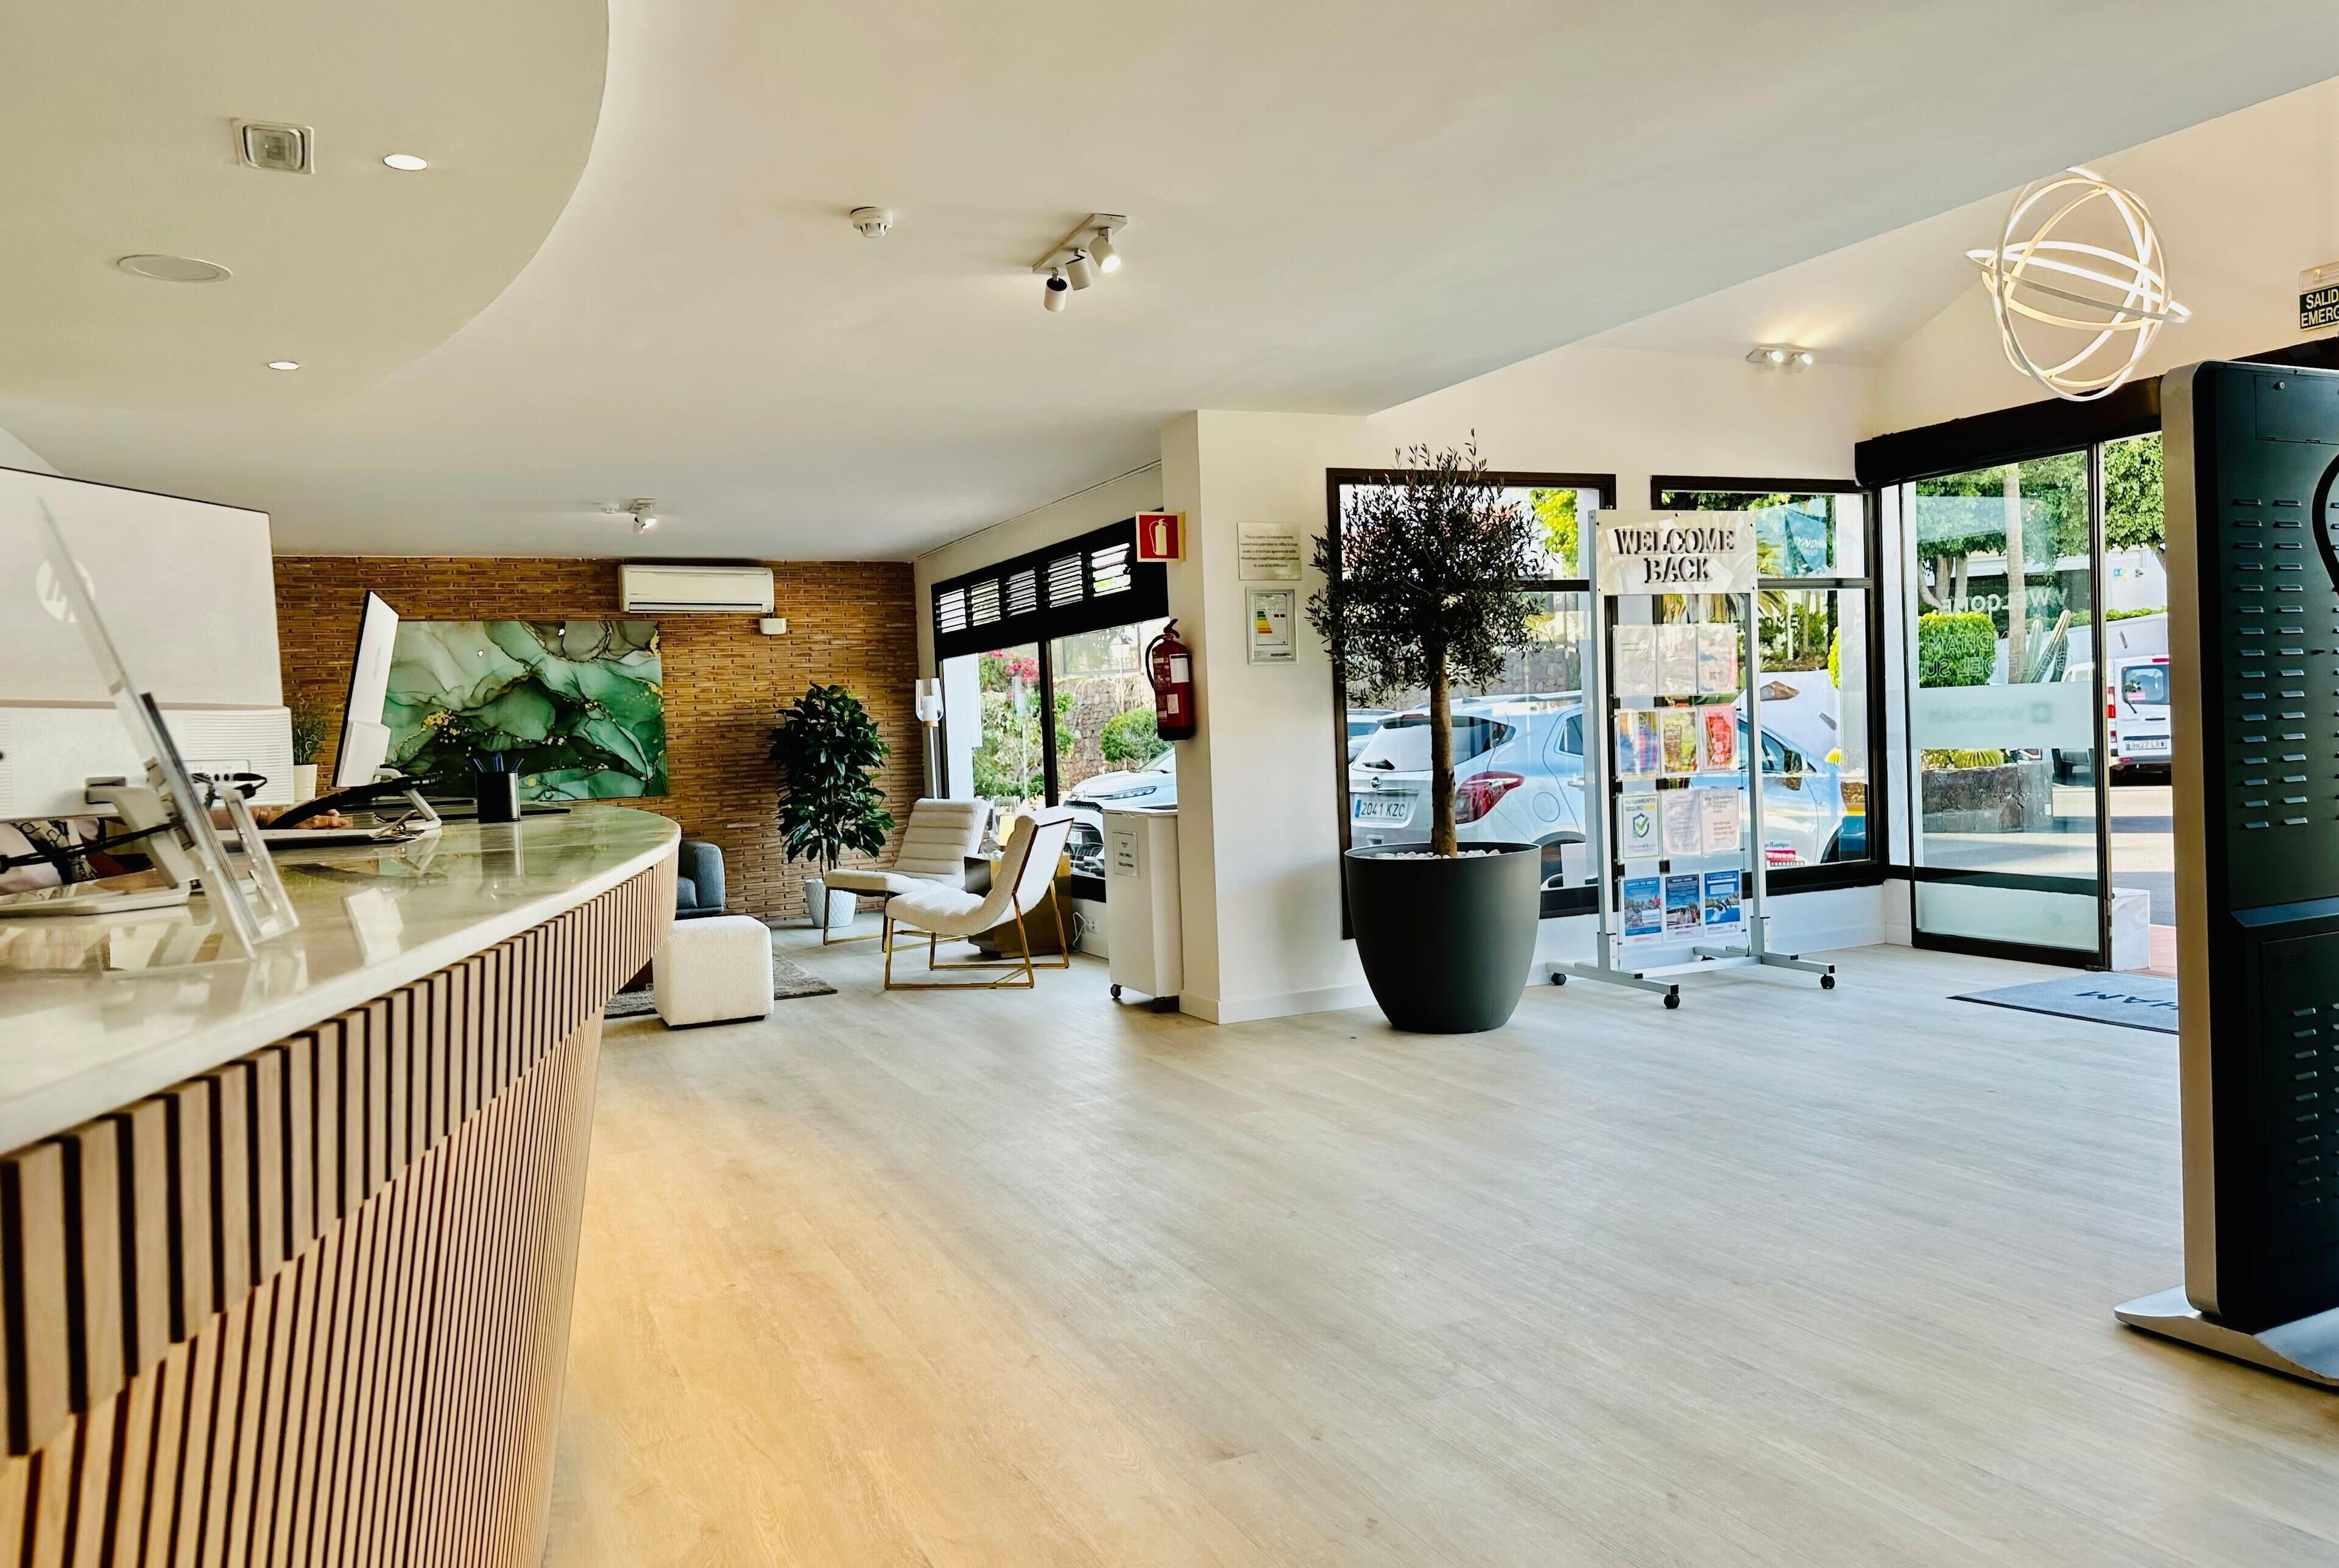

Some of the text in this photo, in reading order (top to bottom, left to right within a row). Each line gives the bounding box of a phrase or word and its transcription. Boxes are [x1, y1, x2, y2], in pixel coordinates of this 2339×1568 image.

[2306, 289, 2339, 309] SALID
[2301, 304, 2339, 327] EMERG
[1615, 527, 1735, 555] WELCOME
[1644, 556, 1713, 583] BACK
[1361, 803, 1405, 817] 2041 KZC
